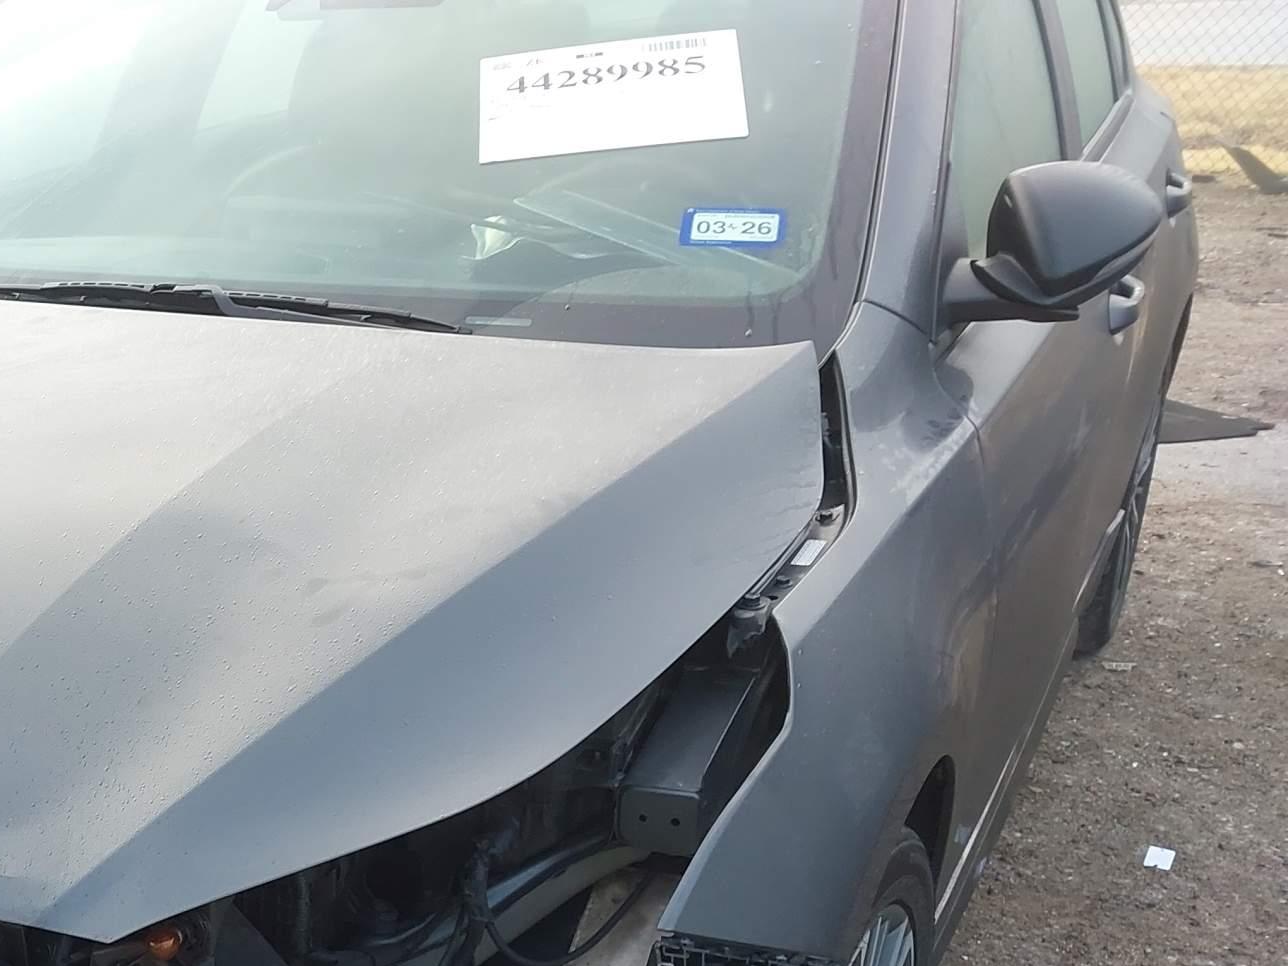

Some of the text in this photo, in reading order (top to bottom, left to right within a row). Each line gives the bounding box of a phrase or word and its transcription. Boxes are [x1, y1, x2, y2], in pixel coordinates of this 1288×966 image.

[506, 56, 707, 94] 44289985
[696, 220, 772, 236] 03 26
